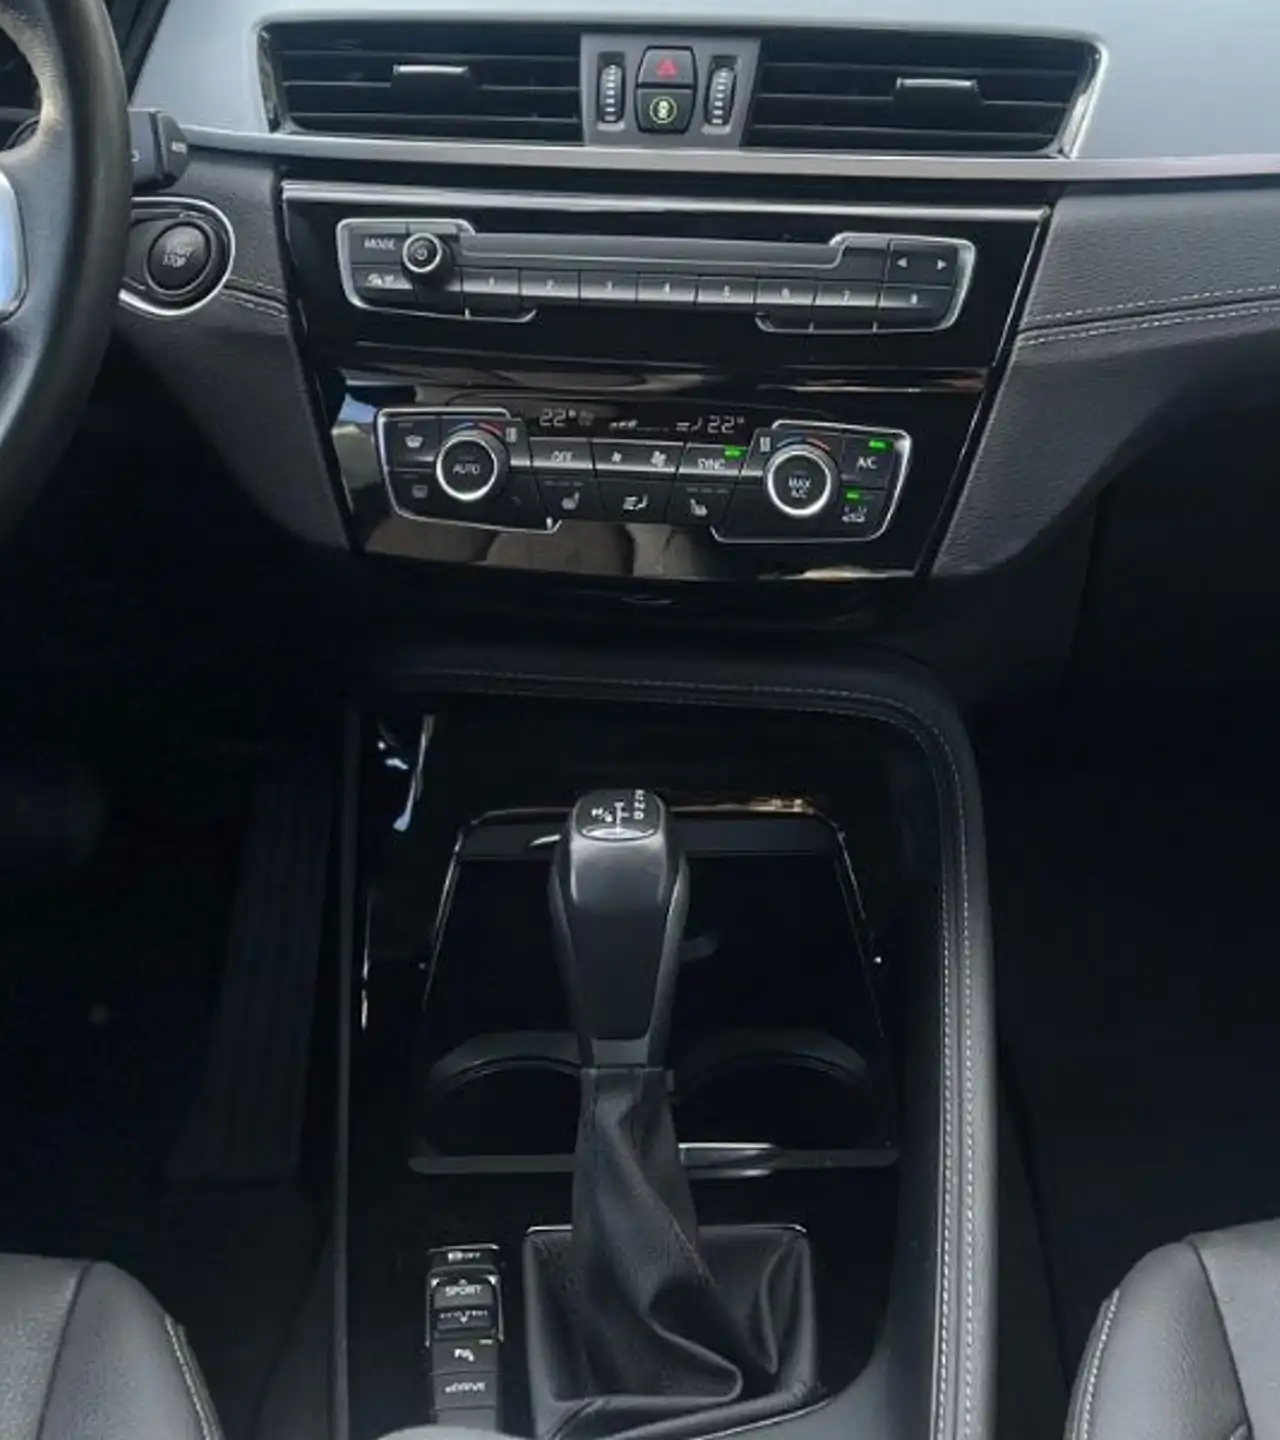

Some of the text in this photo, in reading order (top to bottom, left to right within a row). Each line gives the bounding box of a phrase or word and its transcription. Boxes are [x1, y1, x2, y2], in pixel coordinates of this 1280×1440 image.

[364, 238, 396, 251] MODE
[452, 462, 480, 475] AUTO
[788, 476, 812, 489] MAX
[445, 1285, 482, 1297] SPORT
